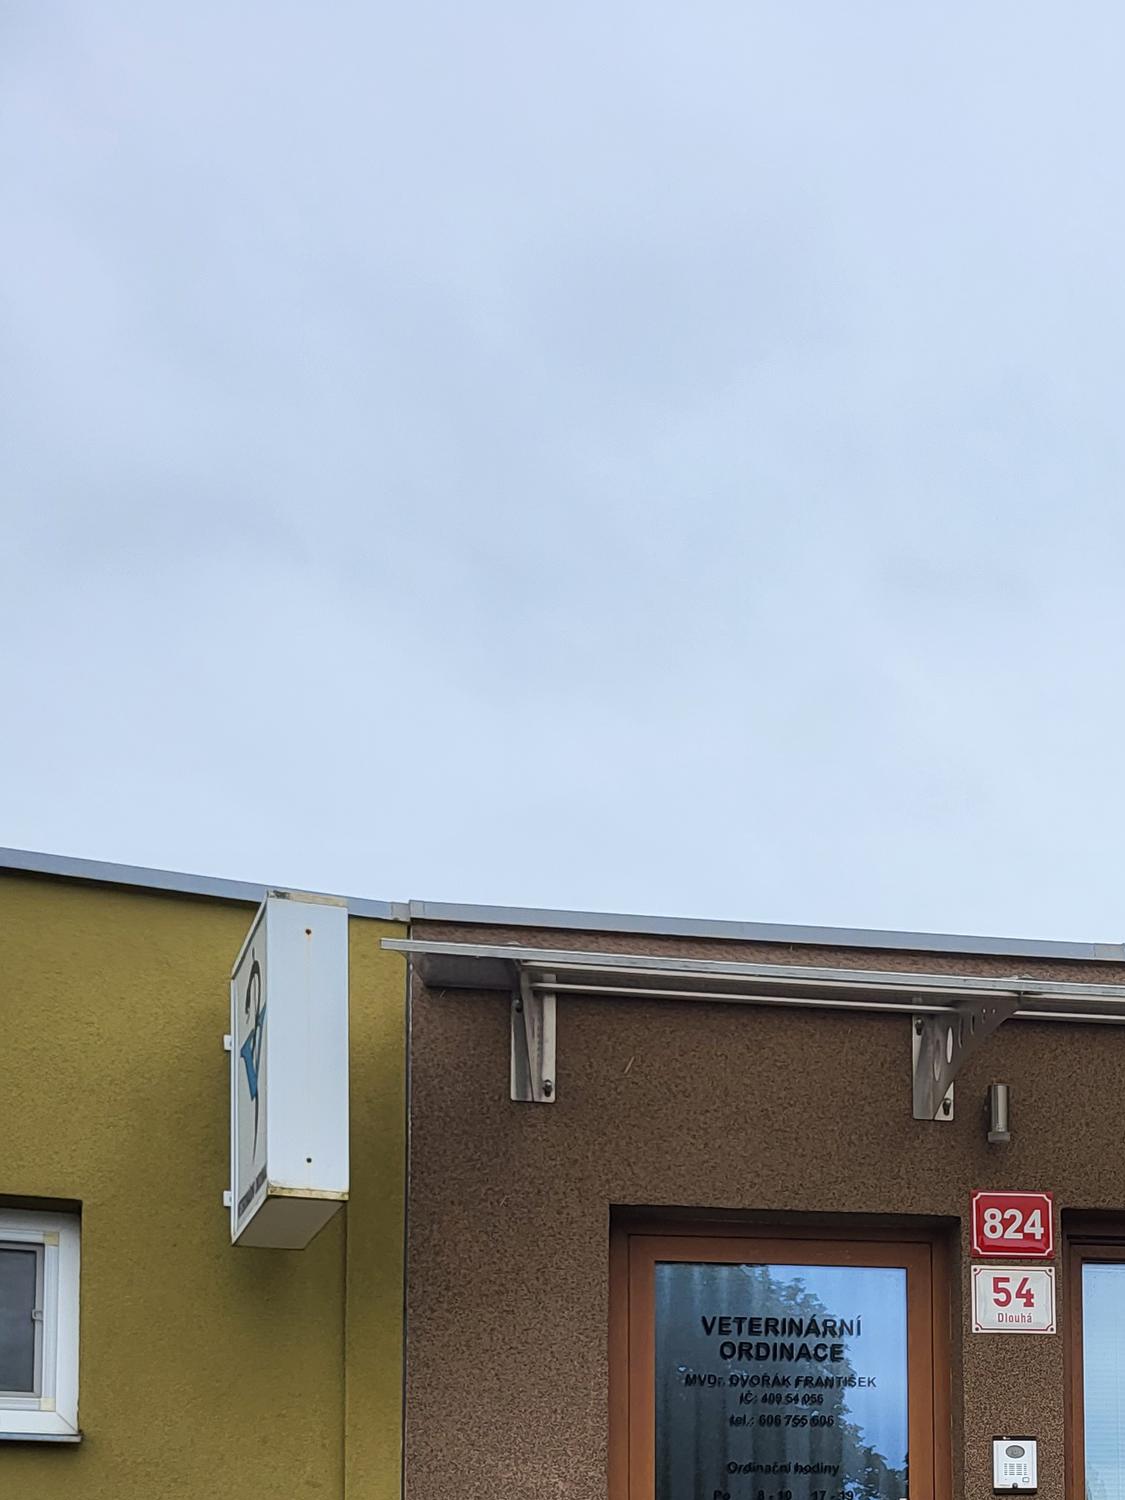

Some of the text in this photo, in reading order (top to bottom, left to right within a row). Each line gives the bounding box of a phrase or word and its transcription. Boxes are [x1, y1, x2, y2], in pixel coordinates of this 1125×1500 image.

[983, 1208, 1044, 1240] 824
[992, 1276, 1035, 1308] 54
[701, 1314, 862, 1338] VETERINÁRNÍ
[997, 1312, 1032, 1323] Dlouhá
[719, 1341, 845, 1362] ORDINACE
[685, 1371, 877, 1388] MVDr. DVOŘÁK FRANTIŠEK
[758, 1414, 781, 1427] 606
[727, 1461, 839, 1477] Ordinační hodiny
